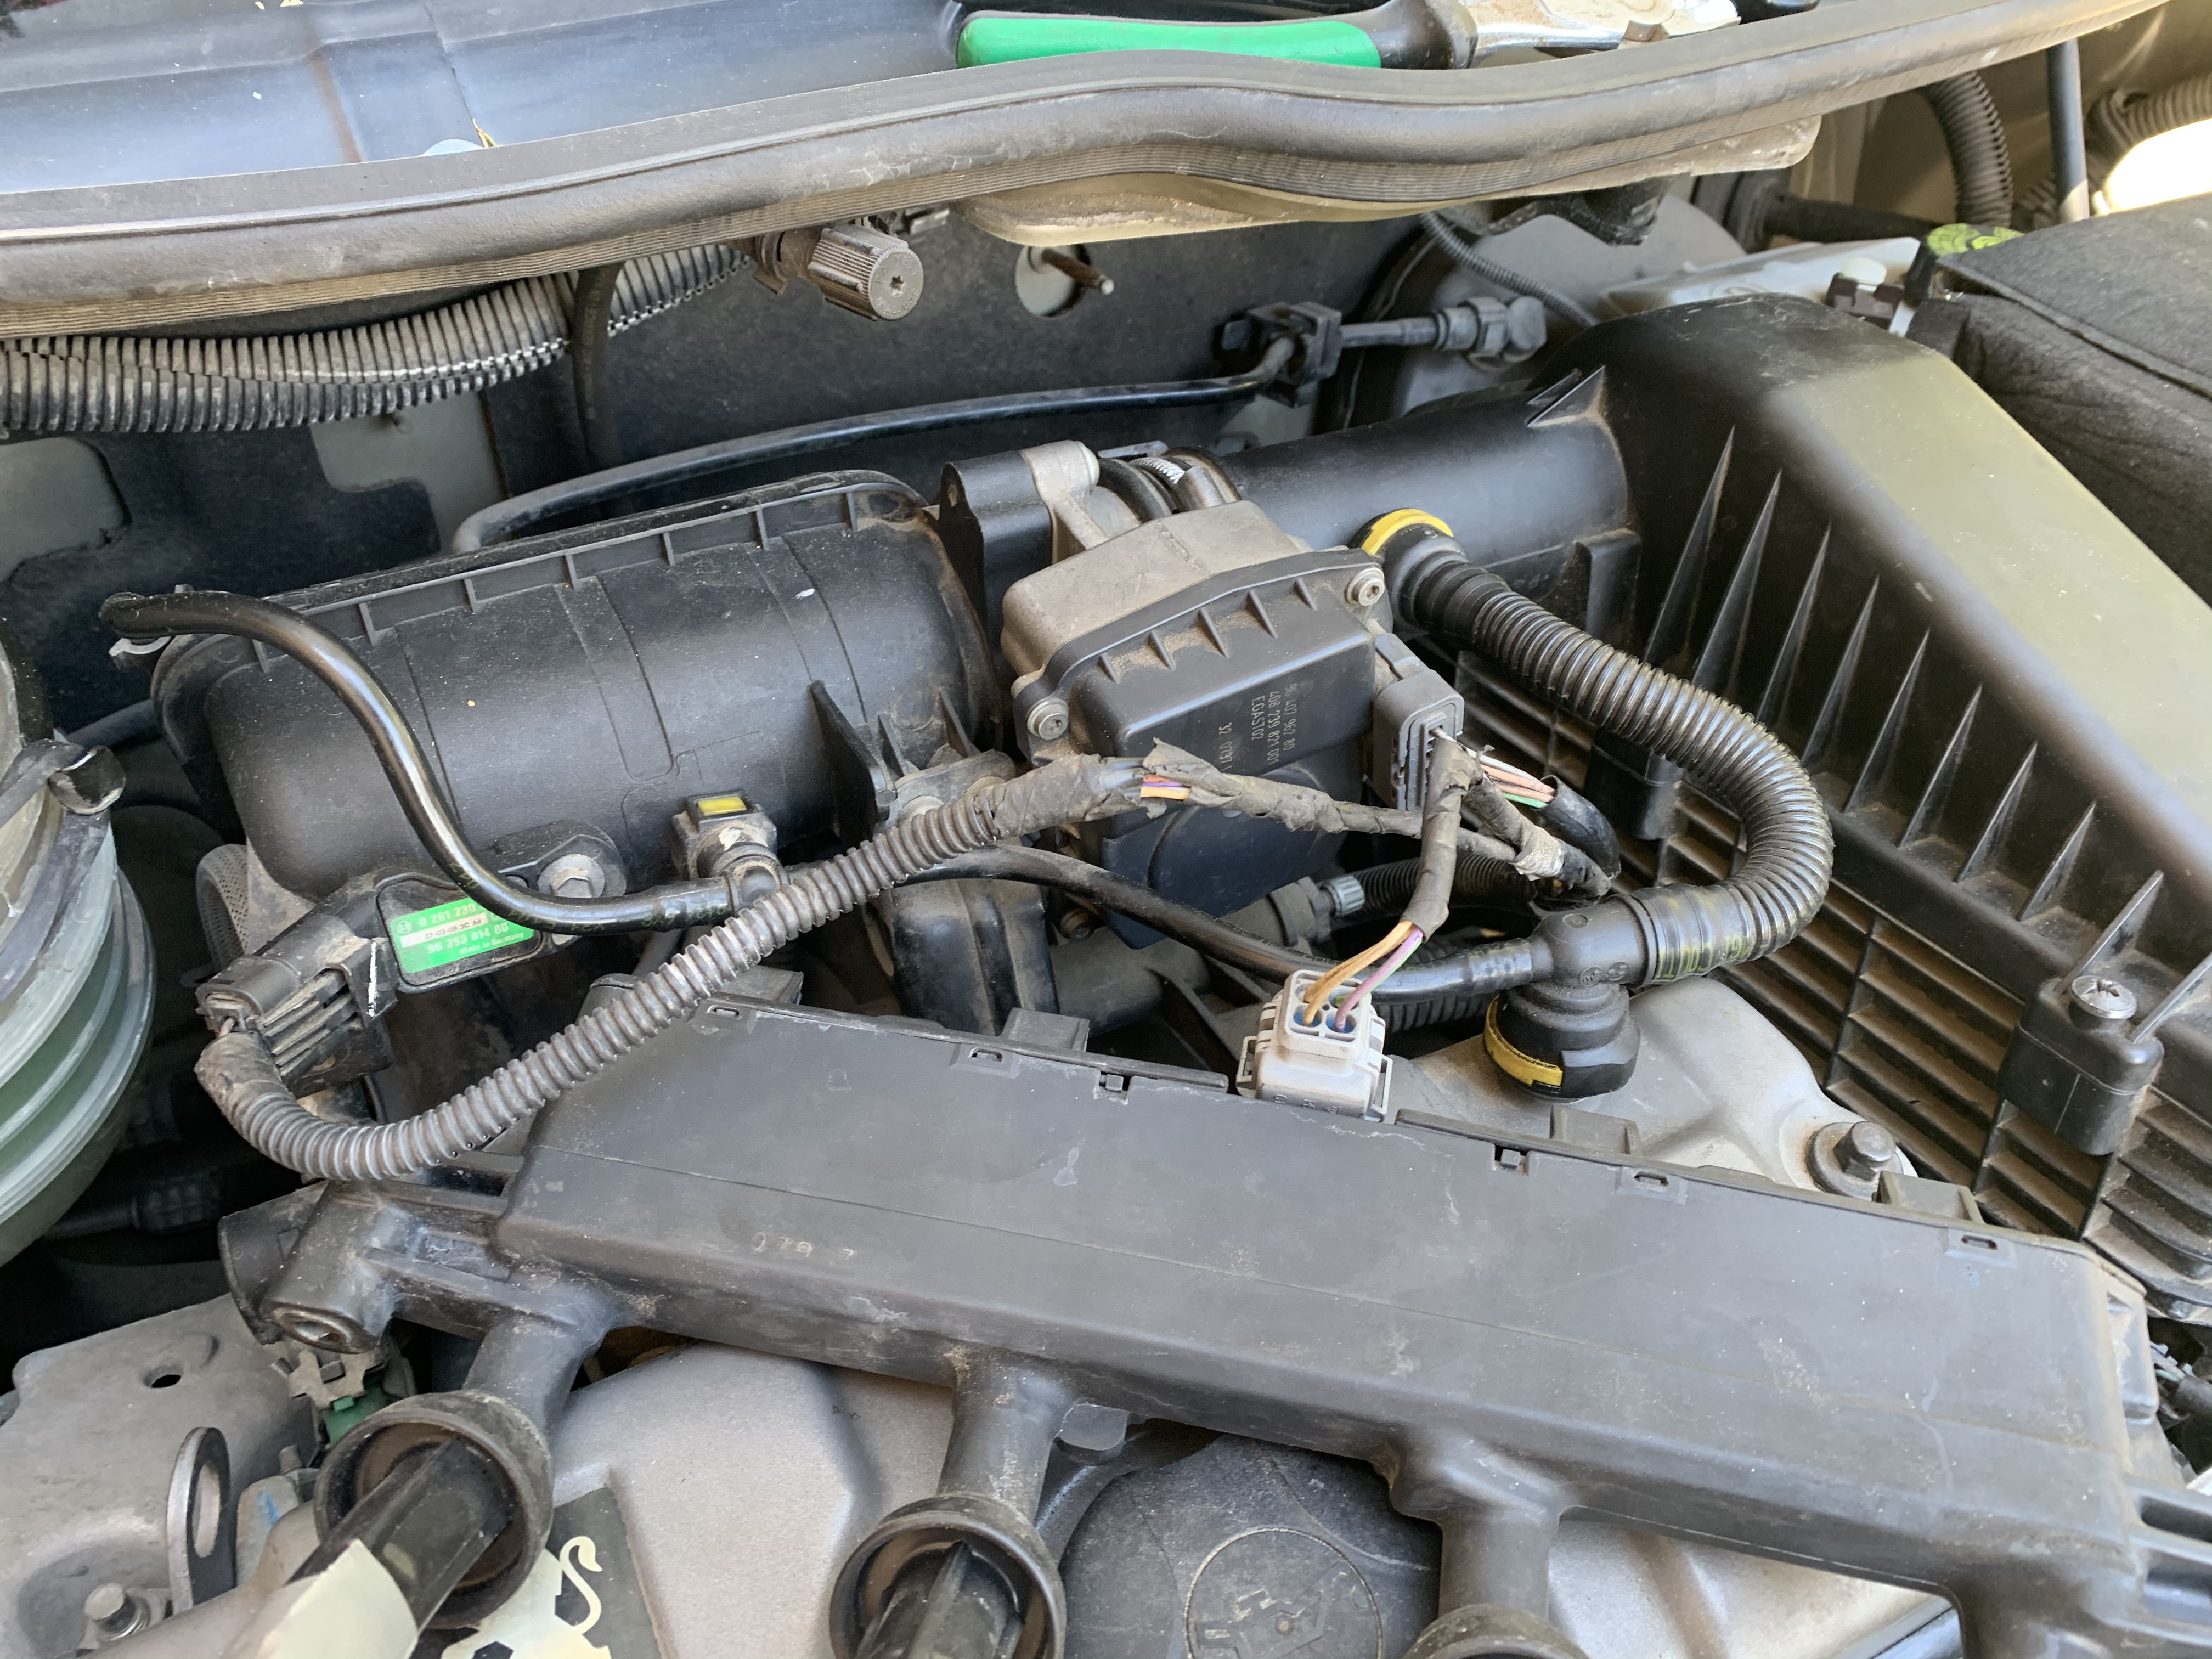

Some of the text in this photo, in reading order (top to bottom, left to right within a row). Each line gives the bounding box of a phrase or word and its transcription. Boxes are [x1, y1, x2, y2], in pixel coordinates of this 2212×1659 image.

[1268, 710, 1281, 729] 239
[1283, 718, 1296, 735] 962
[1218, 722, 1232, 735] 32
[1268, 730, 1280, 747] 821
[1283, 738, 1296, 751] 80
[1267, 748, 1279, 765] 001
[430, 910, 450, 923] 261
[454, 903, 476, 917] 230
[427, 923, 509, 954] 96 393 814 80
